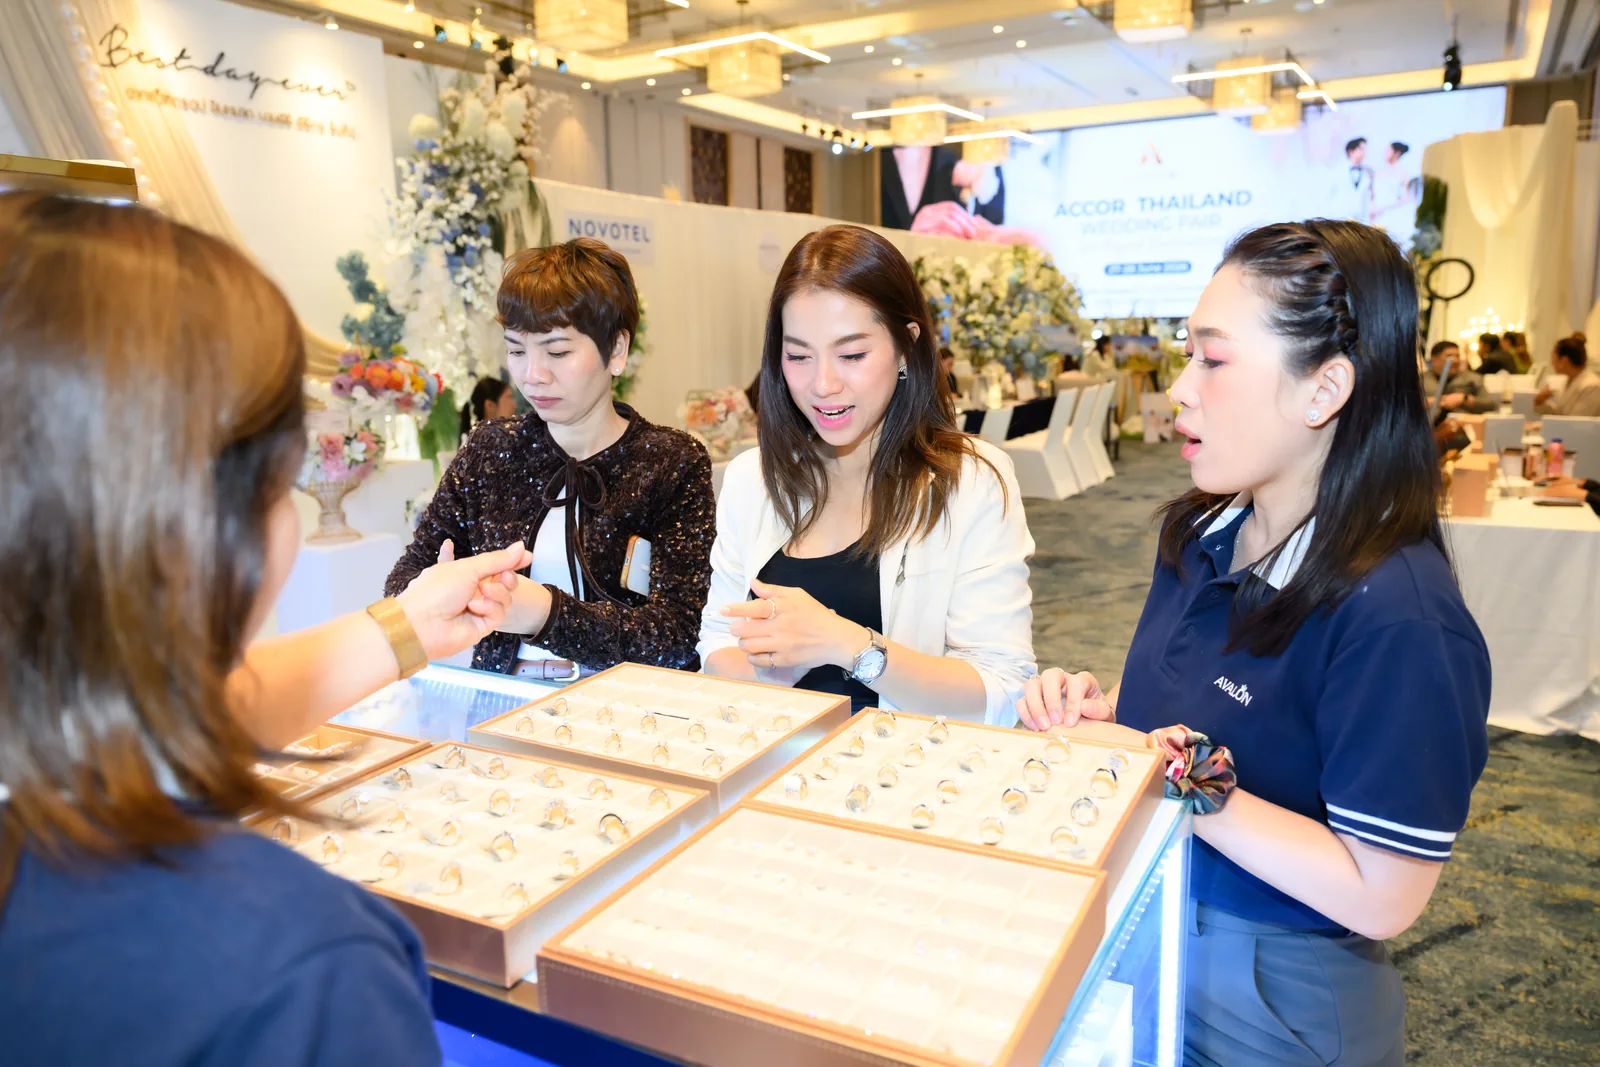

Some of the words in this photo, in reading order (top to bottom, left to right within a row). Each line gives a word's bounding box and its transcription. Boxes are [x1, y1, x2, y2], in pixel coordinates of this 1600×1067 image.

[100, 24, 191, 69] Best
[202, 52, 268, 99] day
[279, 78, 347, 100] ever
[1054, 199, 1126, 218] ACCOR
[1137, 190, 1253, 213] THAILAND
[568, 218, 651, 243] NOVOTEL
[1081, 217, 1172, 235] WEDDING
[1178, 213, 1222, 231] FAIR
[1213, 675, 1253, 707] AVALON
